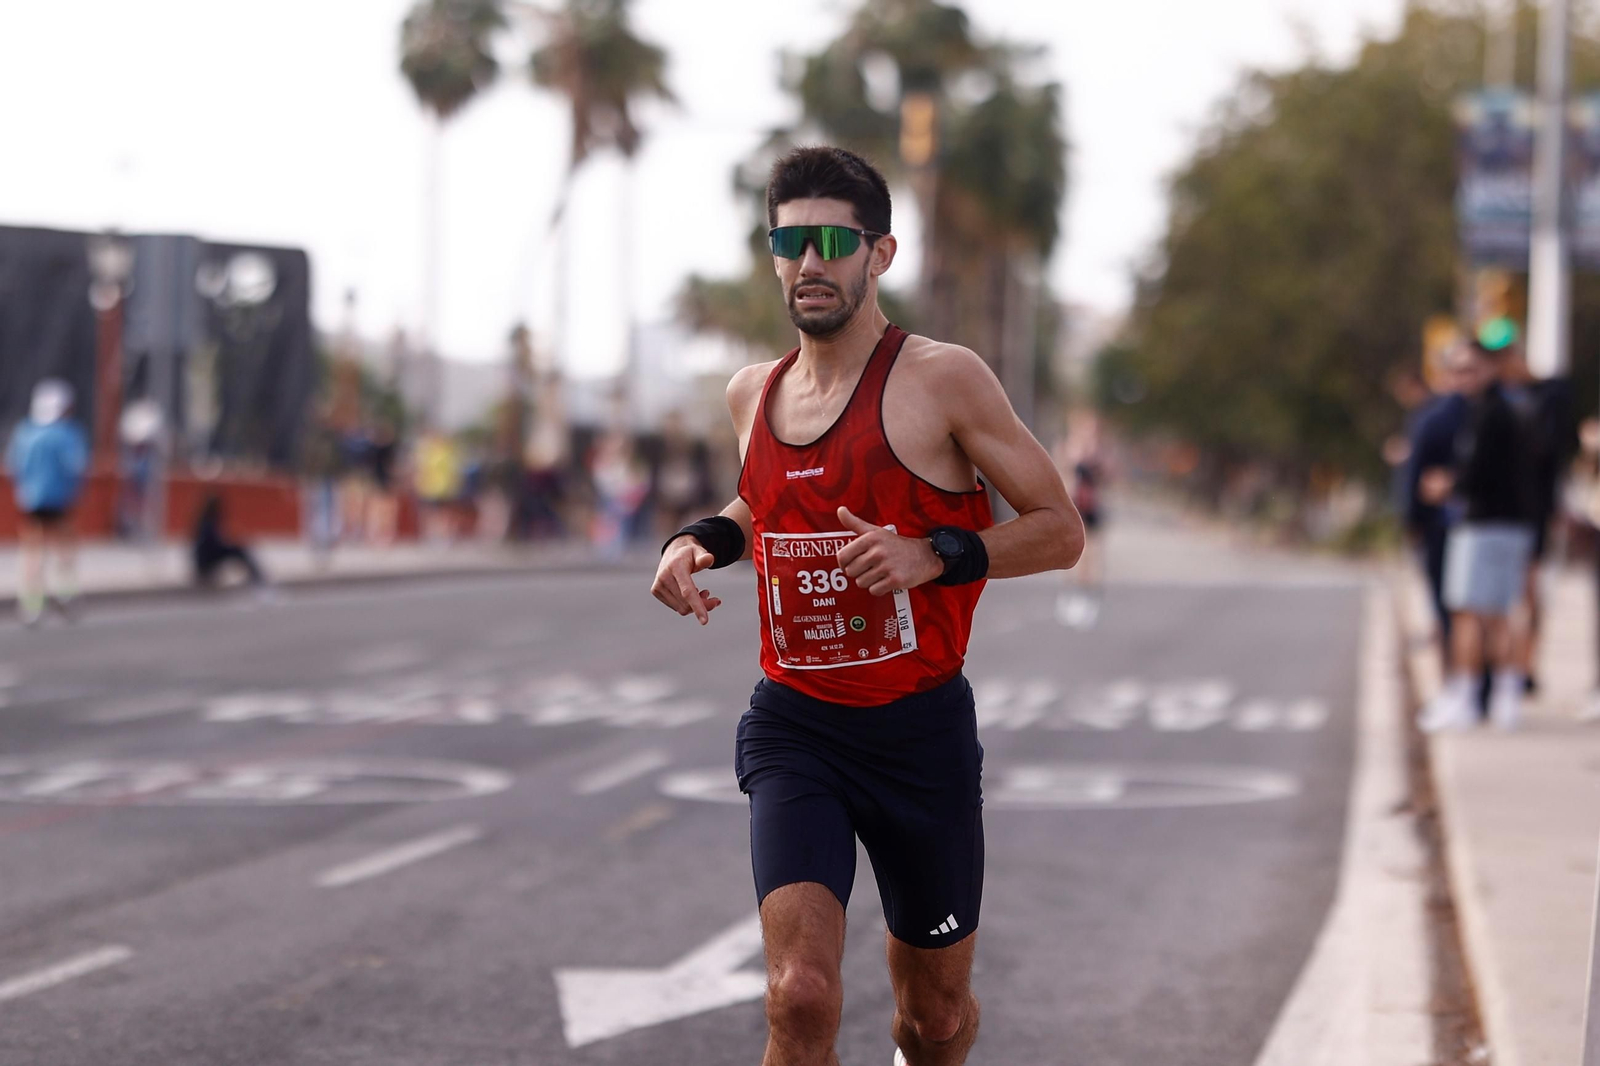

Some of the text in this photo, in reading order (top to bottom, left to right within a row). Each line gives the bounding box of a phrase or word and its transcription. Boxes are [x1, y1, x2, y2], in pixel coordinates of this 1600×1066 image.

[796, 568, 848, 594] 336
[812, 597, 836, 607] DANI
[801, 614, 832, 622] GENERALI
[898, 614, 910, 631] BOX
[803, 628, 836, 640] MÁLAGA
[902, 641, 913, 649] 42K
